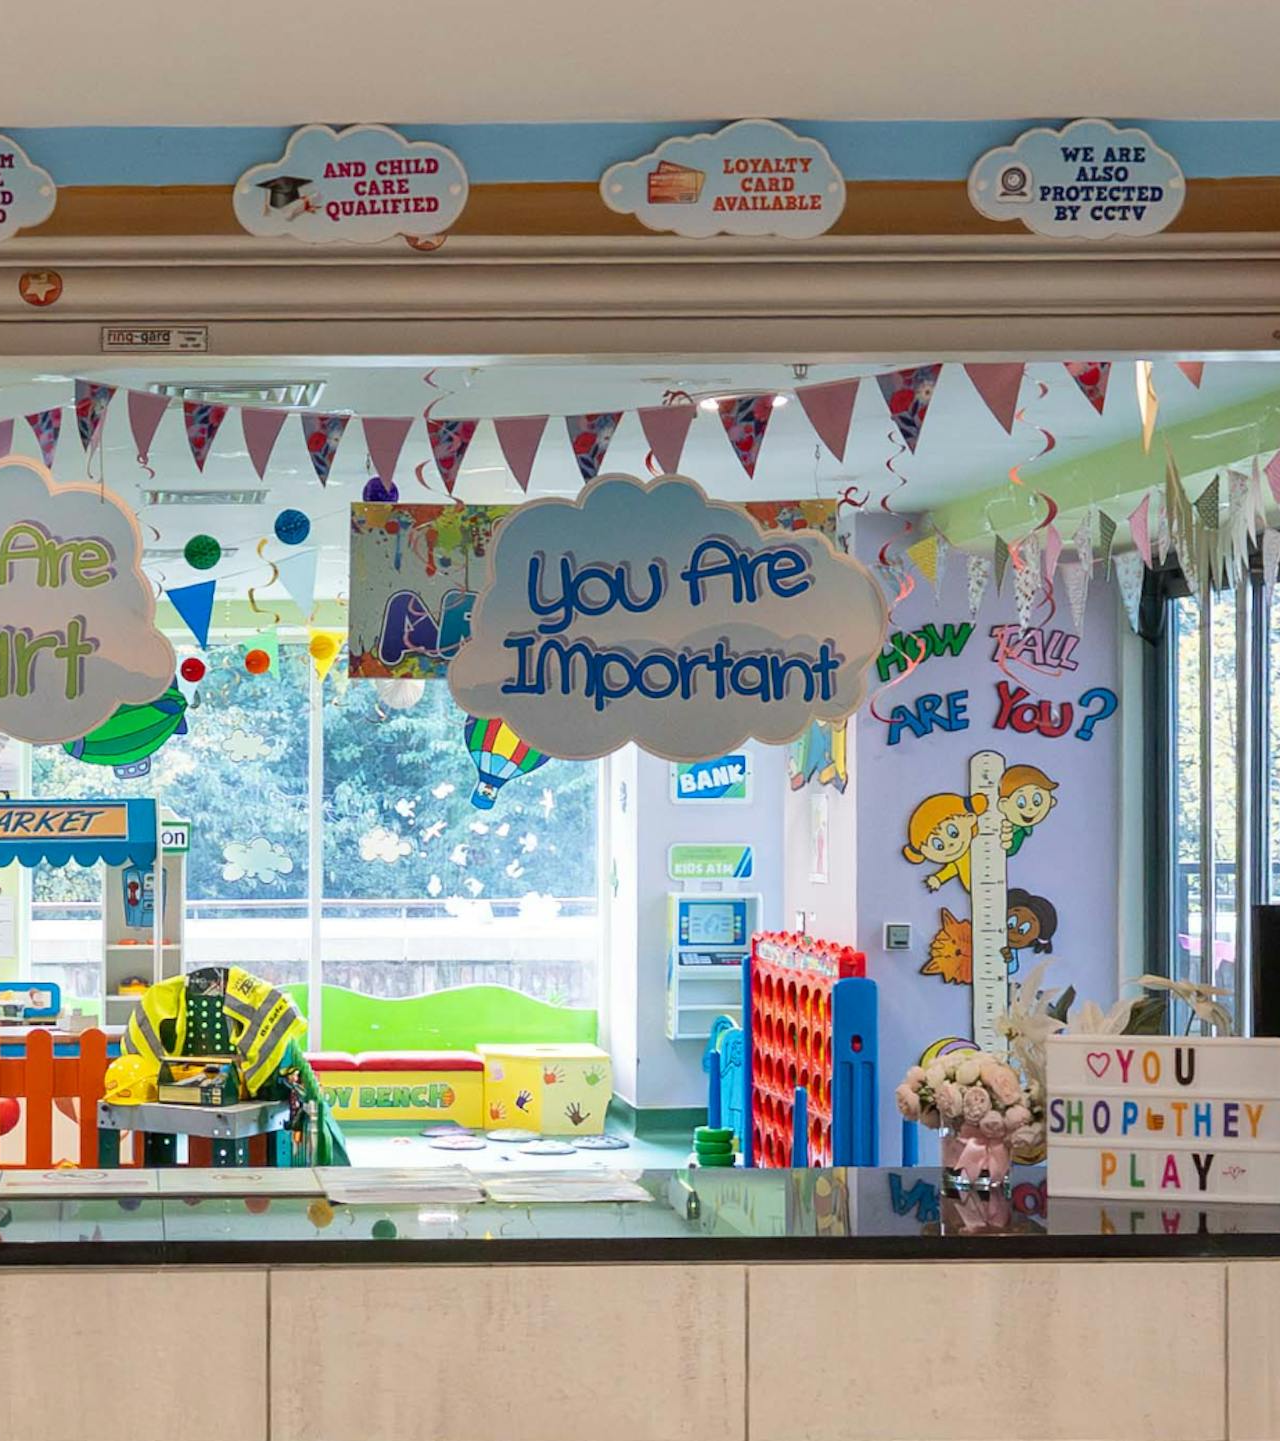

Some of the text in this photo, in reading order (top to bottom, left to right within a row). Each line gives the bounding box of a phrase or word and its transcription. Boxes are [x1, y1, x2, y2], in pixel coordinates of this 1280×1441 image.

[722, 157, 812, 174] LOYALTY
[1061, 147, 1145, 162] WE ARE
[323, 158, 439, 178] AND CHILD
[1075, 166, 1128, 182] ALSO
[353, 179, 410, 196] CARE
[740, 177, 795, 192] CARD
[1039, 186, 1163, 202] PROTECTED
[325, 196, 439, 221] QUALIFIED
[713, 195, 822, 211] AVAILABLE
[1054, 205, 1146, 221] BY CCTV
[527, 538, 810, 635] You Are
[876, 622, 1080, 682] HOW TALL
[501, 636, 838, 712] Important
[887, 690, 969, 746] ARE
[679, 763, 744, 794] BANK
[1115, 1048, 1195, 1085] YOU
[359, 1083, 454, 1109] BENCH
[1049, 1099, 1264, 1138] SHOP THEY
[1101, 1152, 1214, 1191] PLAY
